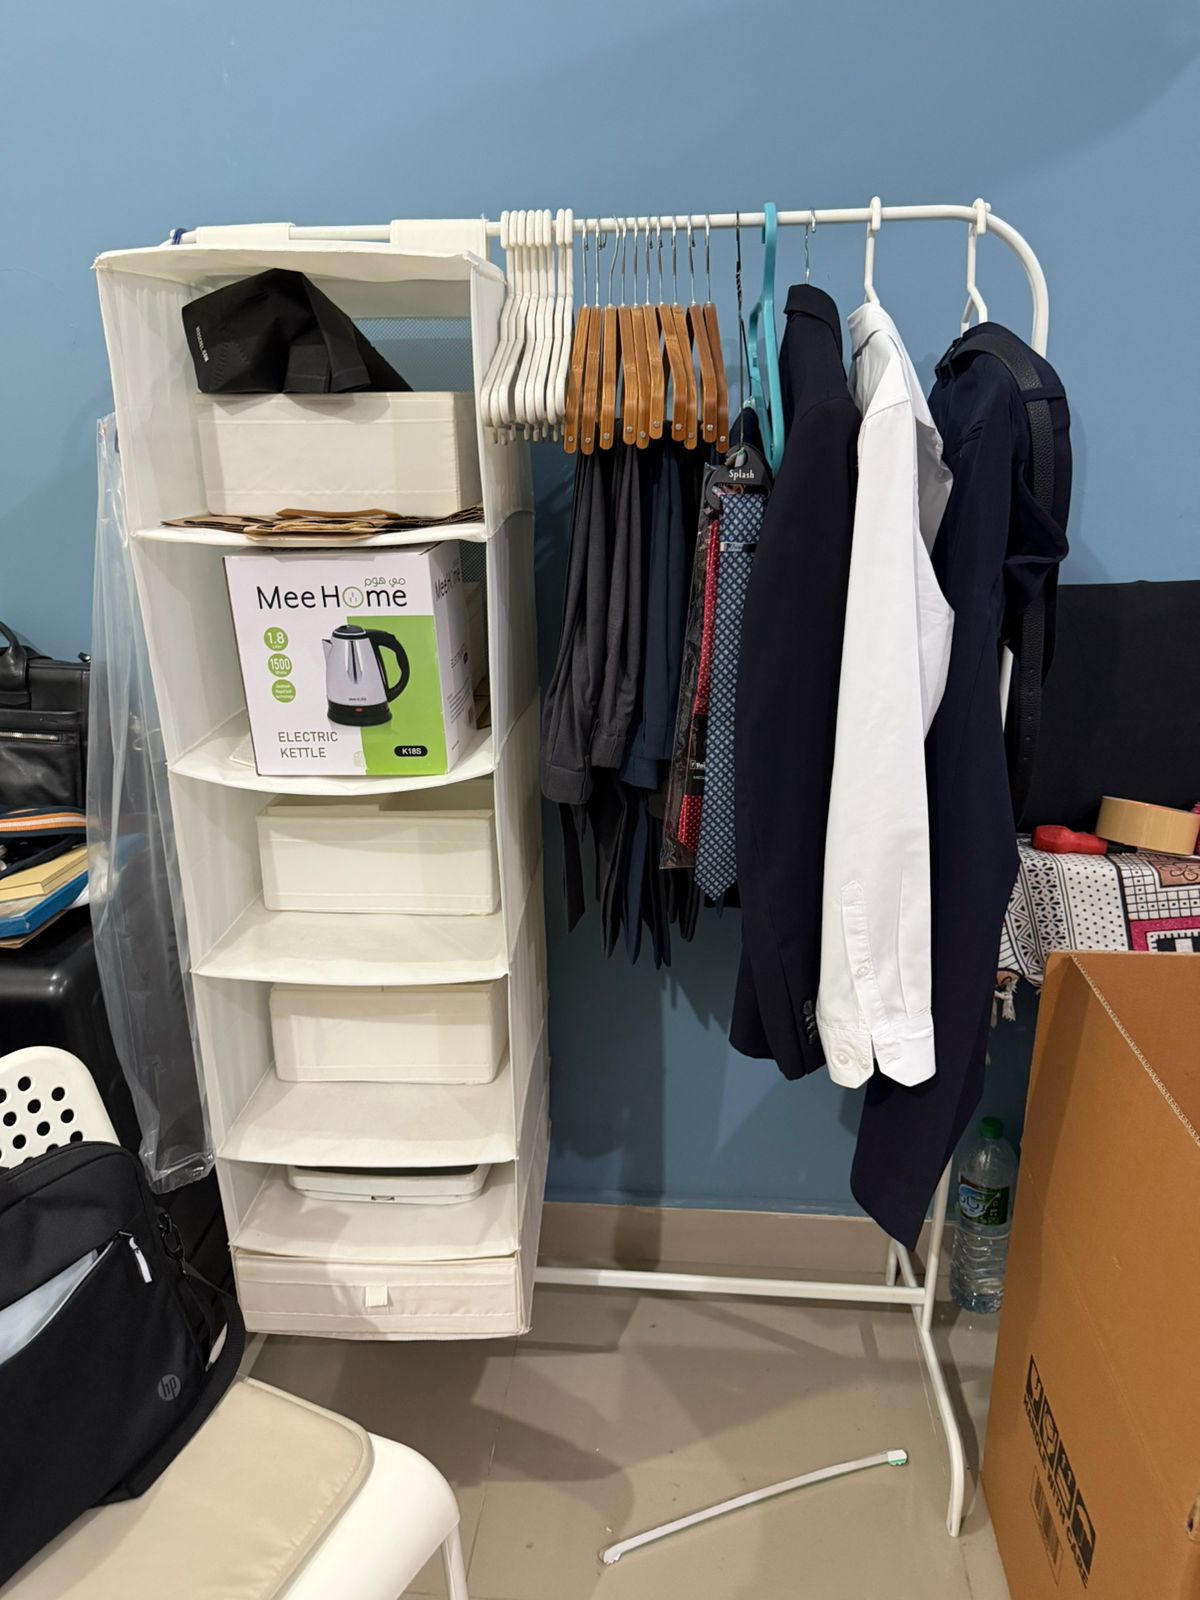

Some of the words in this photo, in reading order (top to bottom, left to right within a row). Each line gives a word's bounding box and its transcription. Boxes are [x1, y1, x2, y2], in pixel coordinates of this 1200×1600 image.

[728, 469, 755, 481] Splash
[267, 631, 285, 645] 1.8
[270, 658, 291, 670] 1500
[278, 731, 338, 743] ELECTRIC
[280, 747, 327, 758] KETTLE
[161, 1375, 177, 1399] hp
